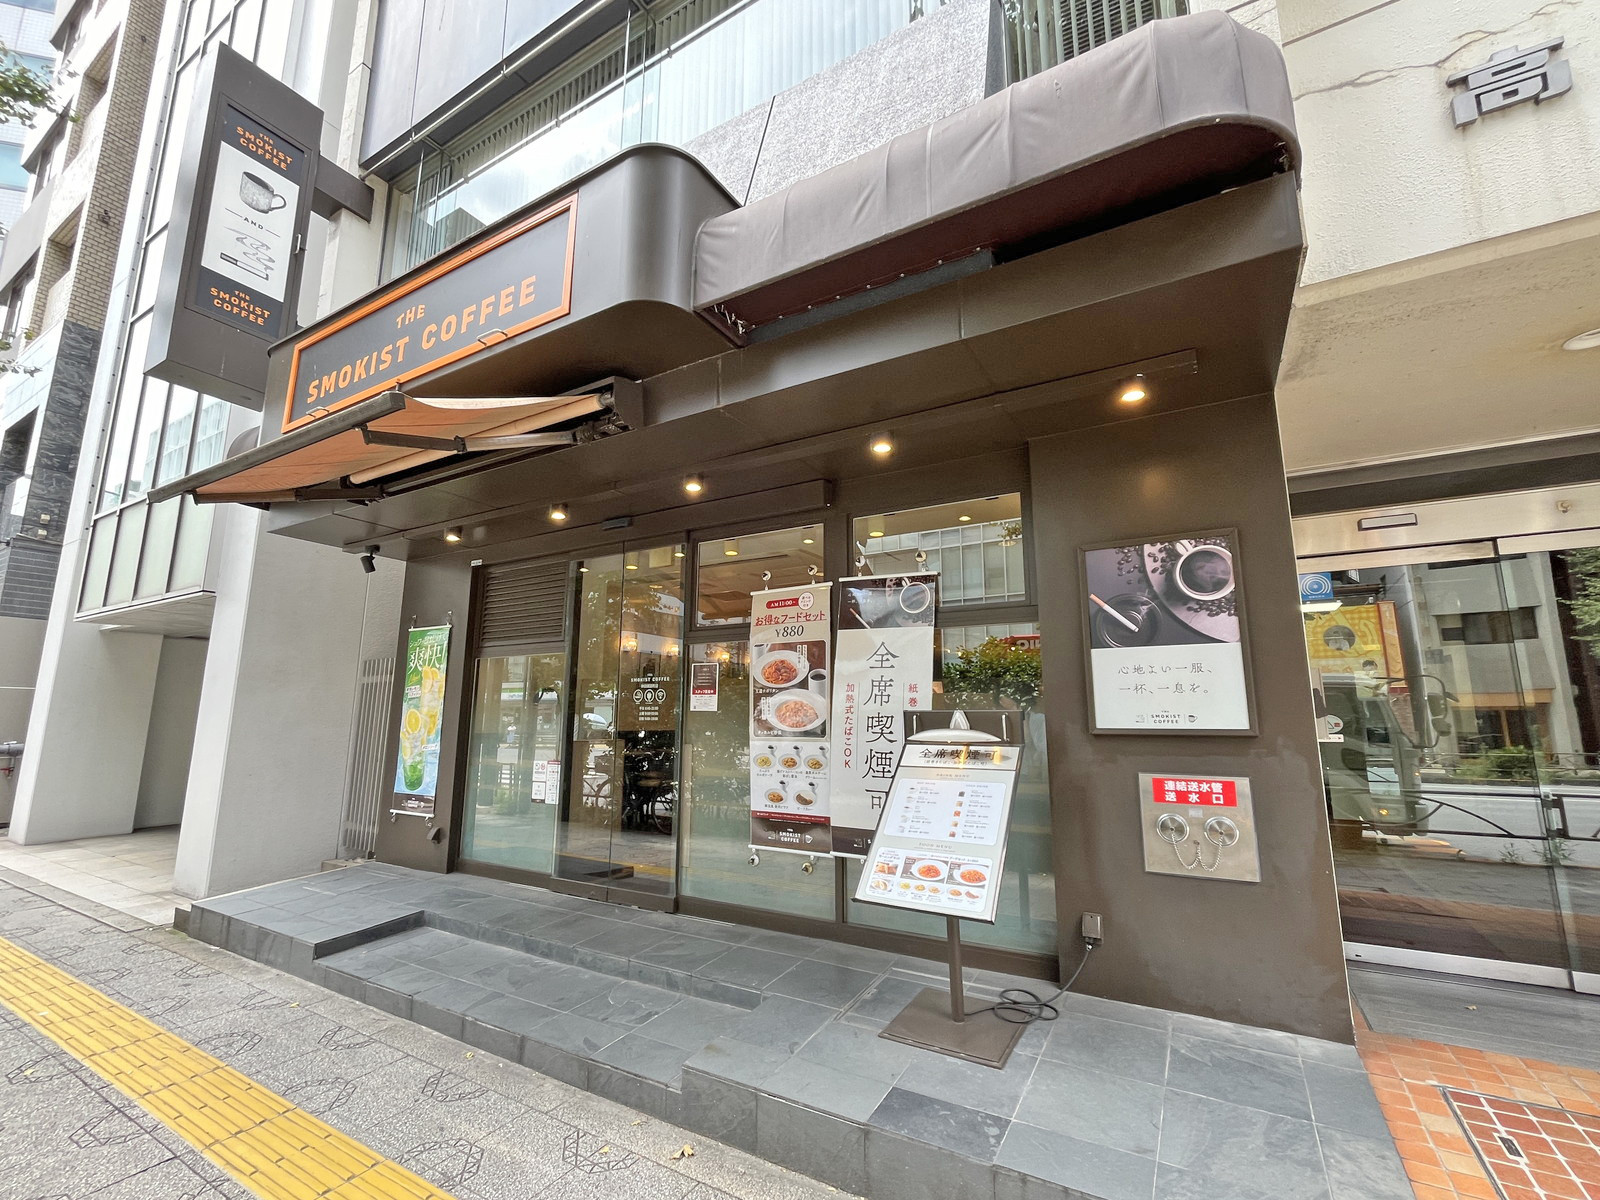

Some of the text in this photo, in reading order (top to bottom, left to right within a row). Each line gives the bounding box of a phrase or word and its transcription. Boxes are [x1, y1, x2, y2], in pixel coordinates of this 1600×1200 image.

[1446, 36, 1572, 129] 高
[236, 126, 293, 164] SMOKIST
[259, 132, 274, 144] THE
[240, 137, 288, 171] COFFEE
[243, 216, 264, 230] AND
[210, 287, 271, 319] SMOKIST
[234, 290, 250, 301] THE
[213, 298, 265, 326] COFFEE
[396, 304, 426, 329] THE
[307, 275, 537, 404] SMOKIST COFFEE
[755, 611, 826, 626] お得なフードセット
[775, 625, 804, 638] ¥880
[1118, 662, 1213, 675] 心地よい一服、
[1119, 682, 1209, 694] 一杯、一息を。
[844, 683, 856, 769] 加熱式たばこOK
[919, 748, 998, 760] 全席喫煙可
[1164, 780, 1223, 793] 連結送水管
